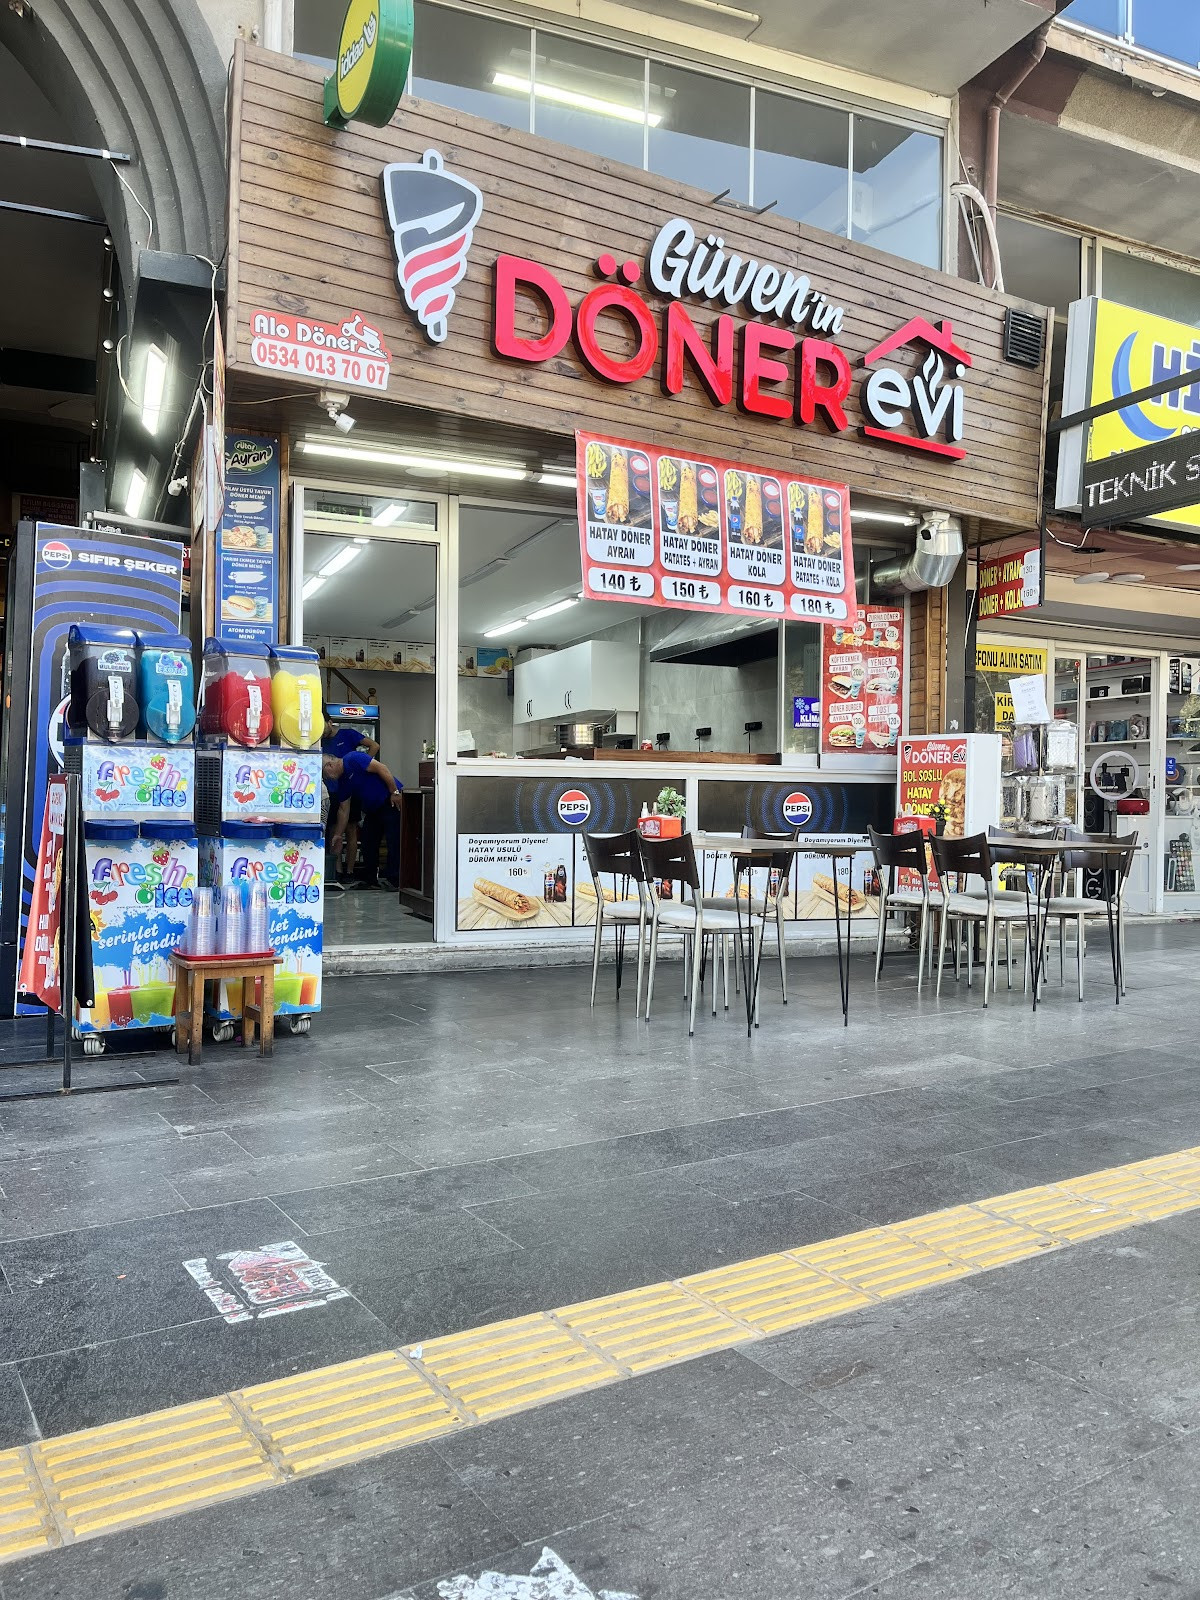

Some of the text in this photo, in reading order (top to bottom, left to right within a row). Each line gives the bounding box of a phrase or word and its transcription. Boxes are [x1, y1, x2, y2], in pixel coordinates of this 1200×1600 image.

[340, 36, 365, 81] iddaa
[254, 313, 358, 353] Alo Döner
[493, 253, 965, 443] DÖNER evi
[256, 342, 386, 385] 0534 013 70 07
[231, 449, 267, 467] Ayran
[1085, 460, 1177, 508] TEKNİK
[589, 526, 651, 546] HATAY DÖNER
[663, 535, 719, 555] HATAY DÖNER
[44, 551, 71, 561] PEPSI
[607, 545, 635, 560] AYRAN
[664, 551, 691, 567] PATATES
[698, 556, 719, 571] AYRAN
[730, 546, 782, 565] HATAY DÖNER
[78, 553, 178, 575] SIFIR ŞEKER
[747, 564, 767, 578] KOLA
[793, 555, 841, 574] HATAY DÖNER
[600, 572, 641, 592] 140 ₺
[795, 571, 820, 585] PATATES
[825, 575, 841, 588] KOLA
[980, 564, 998, 589] DÖNER
[672, 581, 709, 600] 150 ₺
[739, 590, 774, 608] 160 ₺
[801, 598, 835, 615] 180 ₺
[980, 592, 999, 616] DÖNER
[884, 613, 899, 621] DÖNER
[157, 665, 187, 675] EXOTIC
[999, 651, 1018, 668] ALIM
[1019, 653, 1042, 670] SATIM
[830, 704, 845, 713] DÖNER
[876, 706, 890, 714] TOST
[912, 748, 951, 764] DÖNER
[96, 760, 181, 791] fresh
[235, 764, 310, 793] fresh
[903, 769, 943, 783] BOL SOSLU
[152, 784, 187, 808] ice
[283, 787, 315, 809] ice
[907, 786, 934, 800] HATAY
[560, 803, 589, 812] PEPSI
[785, 805, 810, 813] PEPSI
[468, 837, 549, 846] Doyamıyorum Diyene!
[496, 845, 522, 853] USULÜ
[804, 837, 846, 845] Doyamıyorum
[468, 855, 495, 863] DÜRÜM
[496, 854, 518, 862] MENÜ
[91, 857, 188, 887] fresh
[230, 856, 315, 886] fresh
[154, 881, 194, 909] ice
[285, 881, 320, 904] ice
[98, 924, 159, 950] serinlet
